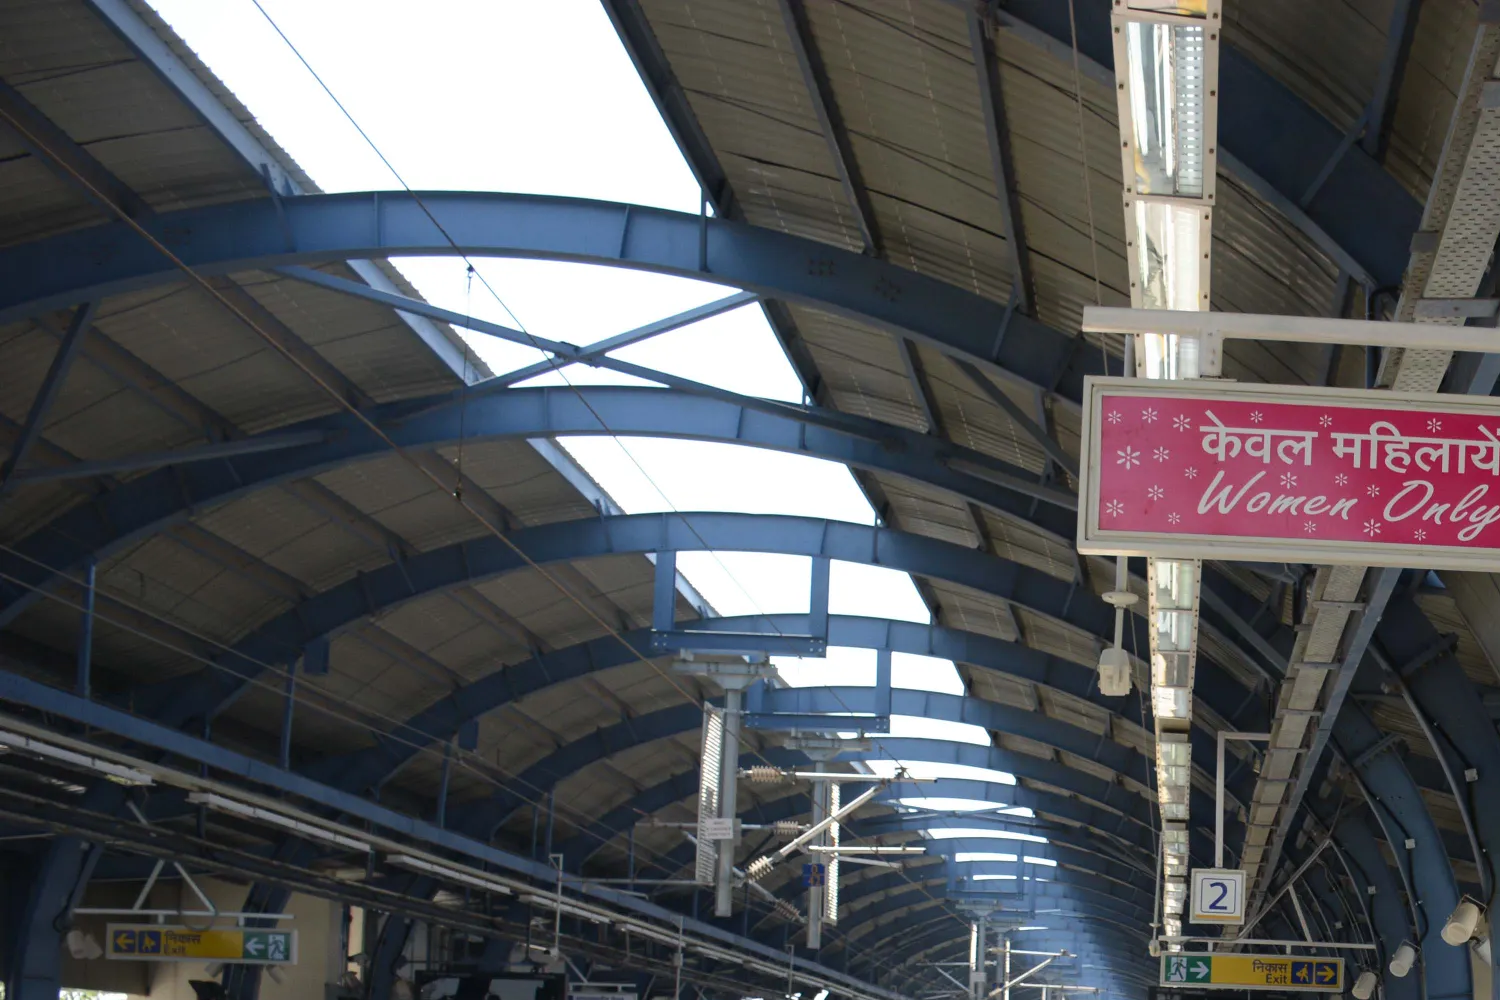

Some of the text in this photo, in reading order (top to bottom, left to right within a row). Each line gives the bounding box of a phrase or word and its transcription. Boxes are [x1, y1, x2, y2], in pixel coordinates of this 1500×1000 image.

[1200, 410, 1318, 465] केवल
[1197, 470, 1358, 520] Women
[1209, 882, 1228, 910] 2
[1252, 959, 1288, 973] निकास
[1266, 974, 1287, 985] Exit
